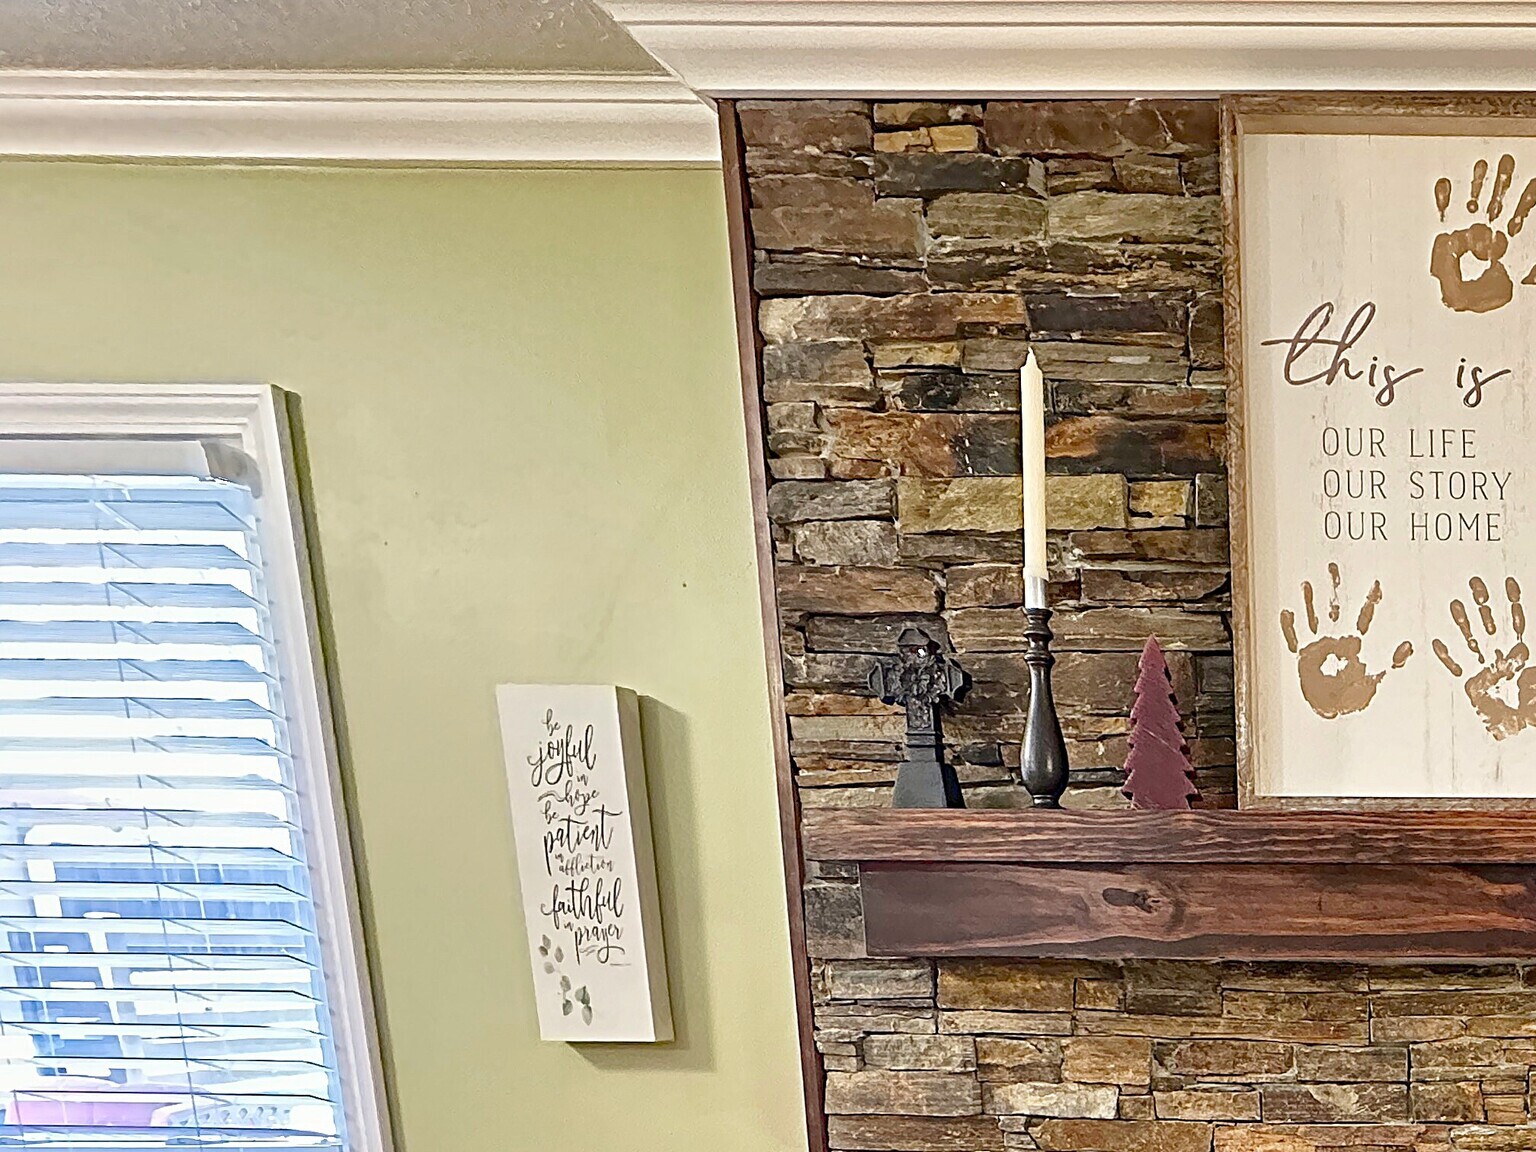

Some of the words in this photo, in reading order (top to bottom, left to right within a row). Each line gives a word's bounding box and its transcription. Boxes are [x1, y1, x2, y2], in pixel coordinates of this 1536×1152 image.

[1261, 301, 1424, 407] this
[1456, 358, 1512, 408] is
[1322, 427, 1386, 458] OUR
[1409, 429, 1476, 459] LIFE
[1323, 469, 1387, 499] OUR
[1410, 471, 1512, 500] STORY
[1324, 511, 1388, 541] OUR
[1411, 512, 1502, 542] HOME
[541, 708, 560, 736] be
[527, 724, 596, 787] joyful
[538, 780, 600, 816] hope
[541, 800, 559, 824] be
[544, 804, 623, 876] patient
[541, 877, 624, 930] faithful
[574, 923, 625, 965] prayer
